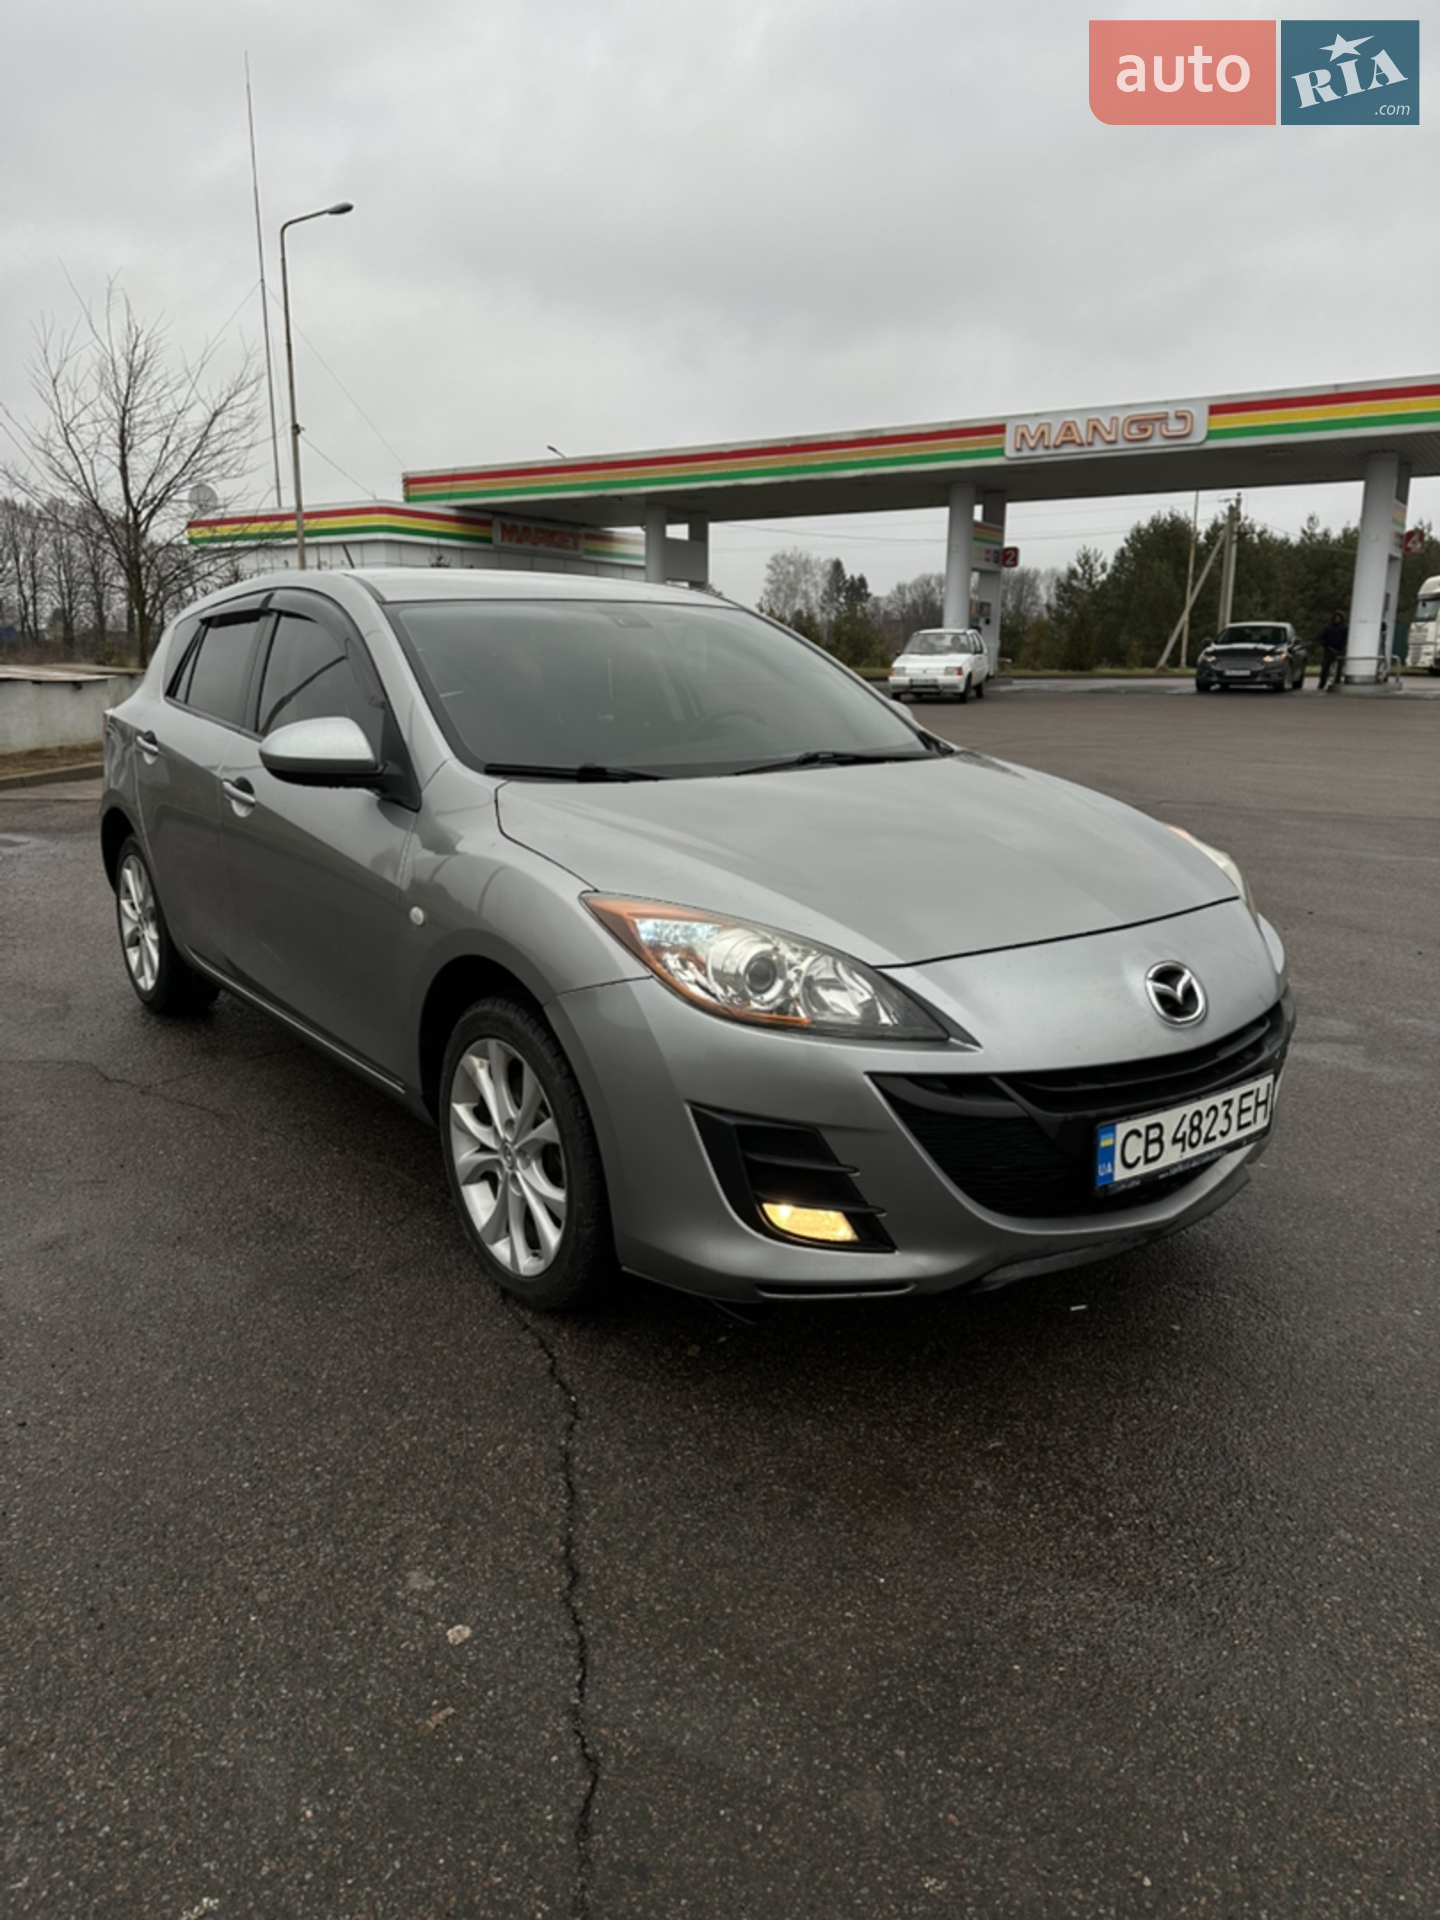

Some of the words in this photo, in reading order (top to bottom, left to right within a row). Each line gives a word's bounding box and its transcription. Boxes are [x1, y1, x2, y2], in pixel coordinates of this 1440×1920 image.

[1014, 409, 1194, 452] MANGO
[501, 522, 582, 551] MARKET
[1005, 550, 1016, 565] 2
[1120, 1121, 1165, 1170] CB
[1171, 1097, 1235, 1153] 4823
[1236, 1082, 1271, 1132] EH
[1098, 1162, 1113, 1176] UA
